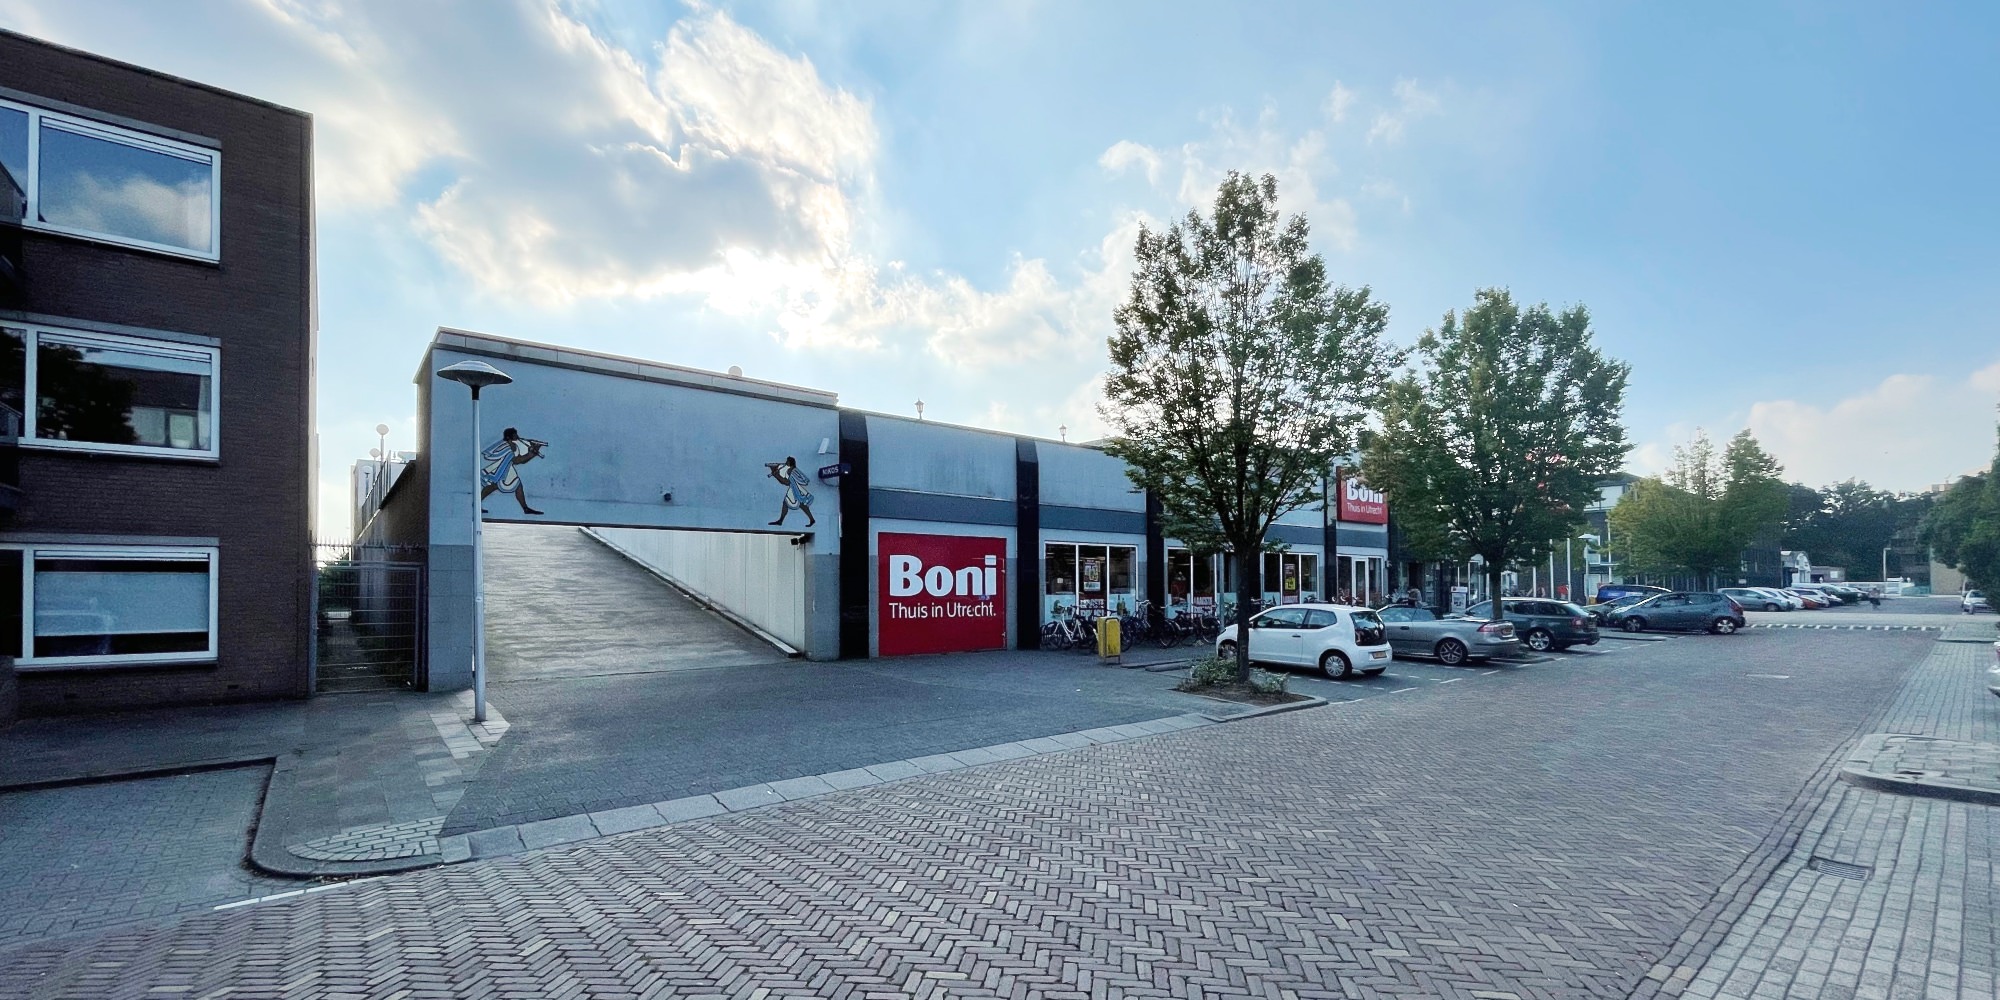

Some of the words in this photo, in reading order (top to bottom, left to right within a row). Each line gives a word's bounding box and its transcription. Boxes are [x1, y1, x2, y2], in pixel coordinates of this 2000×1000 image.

[1347, 502, 1361, 513] Thuis
[1361, 505, 1366, 513] in
[889, 554, 997, 597] Boni
[888, 602, 928, 619] Thuis
[931, 602, 943, 618] in
